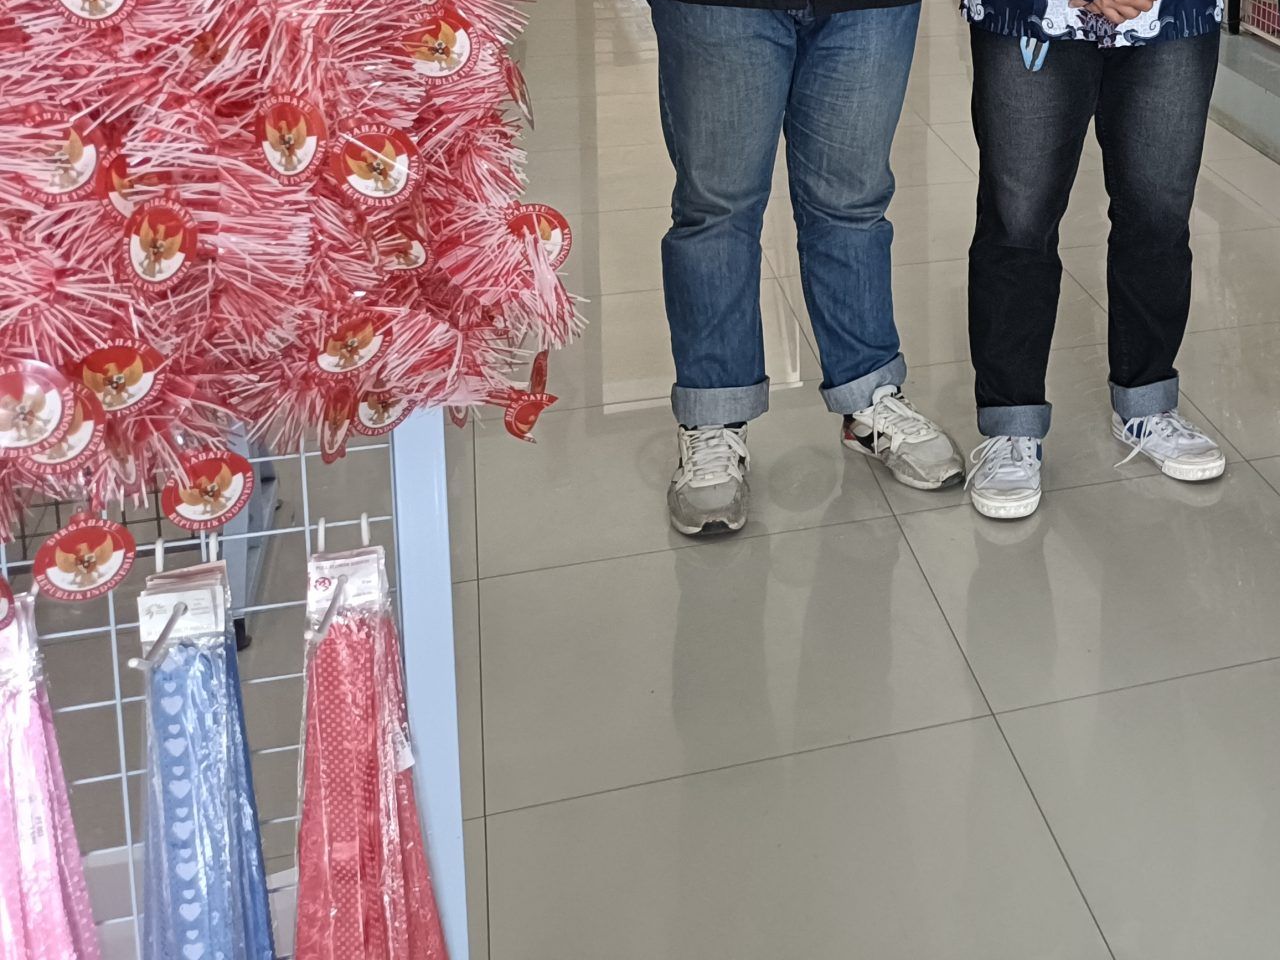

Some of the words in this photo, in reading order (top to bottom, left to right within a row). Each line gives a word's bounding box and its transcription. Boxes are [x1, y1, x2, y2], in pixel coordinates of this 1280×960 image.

[421, 73, 460, 86] PUBLIK
[459, 26, 481, 77] INDONESIA
[258, 95, 313, 115] DIRGAHAYU
[144, 197, 198, 228] DIRGAHAYU
[341, 183, 394, 208] REPUBLIK
[506, 205, 546, 220] GAHAYU
[44, 381, 75, 450] INDONESIA
[116, 373, 166, 418] INDONESIA
[56, 423, 105, 474] INDONESIA
[168, 512, 219, 531] REPUBLIK
[220, 471, 254, 523] INDONESIA
[47, 519, 119, 546] DIRGAHAYU
[35, 574, 83, 601] REPUBLIK
[85, 551, 136, 600] INDONESIA
